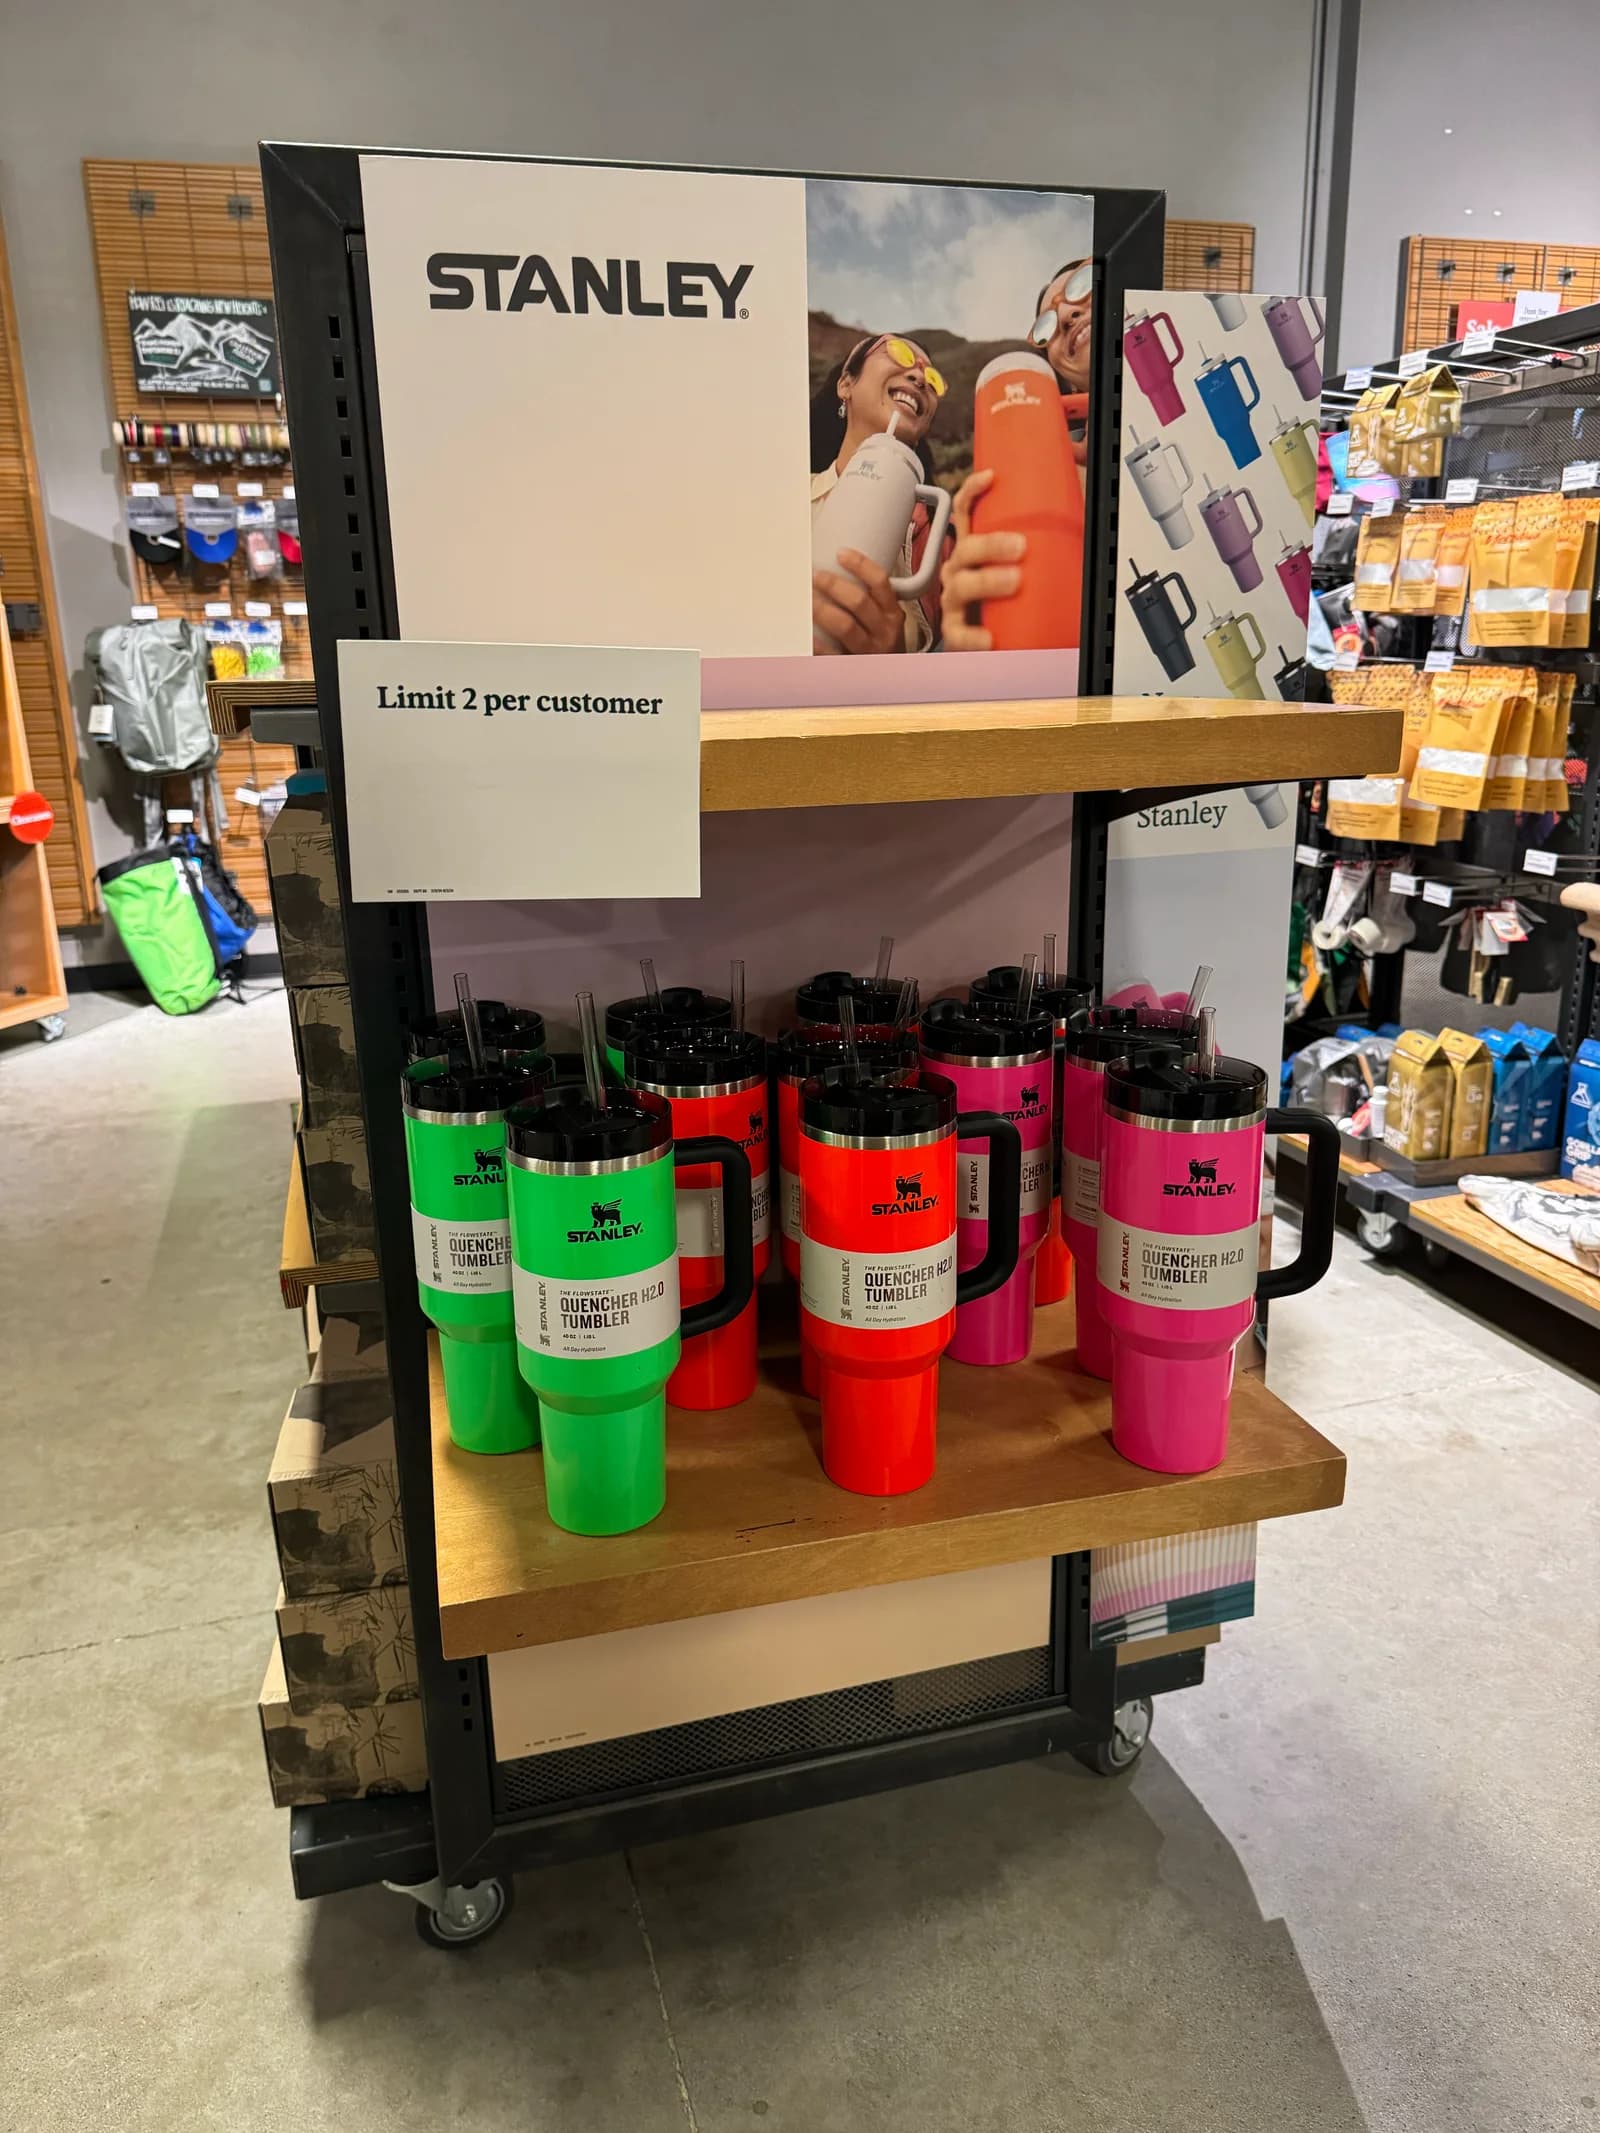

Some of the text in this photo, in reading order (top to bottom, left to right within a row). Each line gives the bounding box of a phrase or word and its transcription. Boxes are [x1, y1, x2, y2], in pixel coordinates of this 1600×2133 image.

[377, 685, 663, 717] Limit 2 per customer
[1137, 800, 1228, 830] Stanley
[453, 1174, 507, 1186] STANL
[970, 1160, 978, 1202] STANLEY
[1163, 1183, 1236, 1197] STANLEY
[871, 1195, 939, 1216] STANLEY
[567, 1222, 643, 1243] STANLEY
[1143, 1241, 1153, 1249] THE
[430, 1223, 440, 1270] STANLEY
[1121, 1232, 1131, 1280] STANLEY
[1142, 1248, 1244, 1268] QUENCHER H2.0
[841, 1257, 850, 1306] STANLEY
[865, 1256, 953, 1287] QUENCHER H2.0
[1141, 1264, 1208, 1284] TUMBLER
[560, 1281, 665, 1313] QUENCHER H2.0
[864, 1283, 927, 1303] TUMBLER
[538, 1281, 548, 1332] STANLEY
[560, 1310, 630, 1329] TUMBLER
